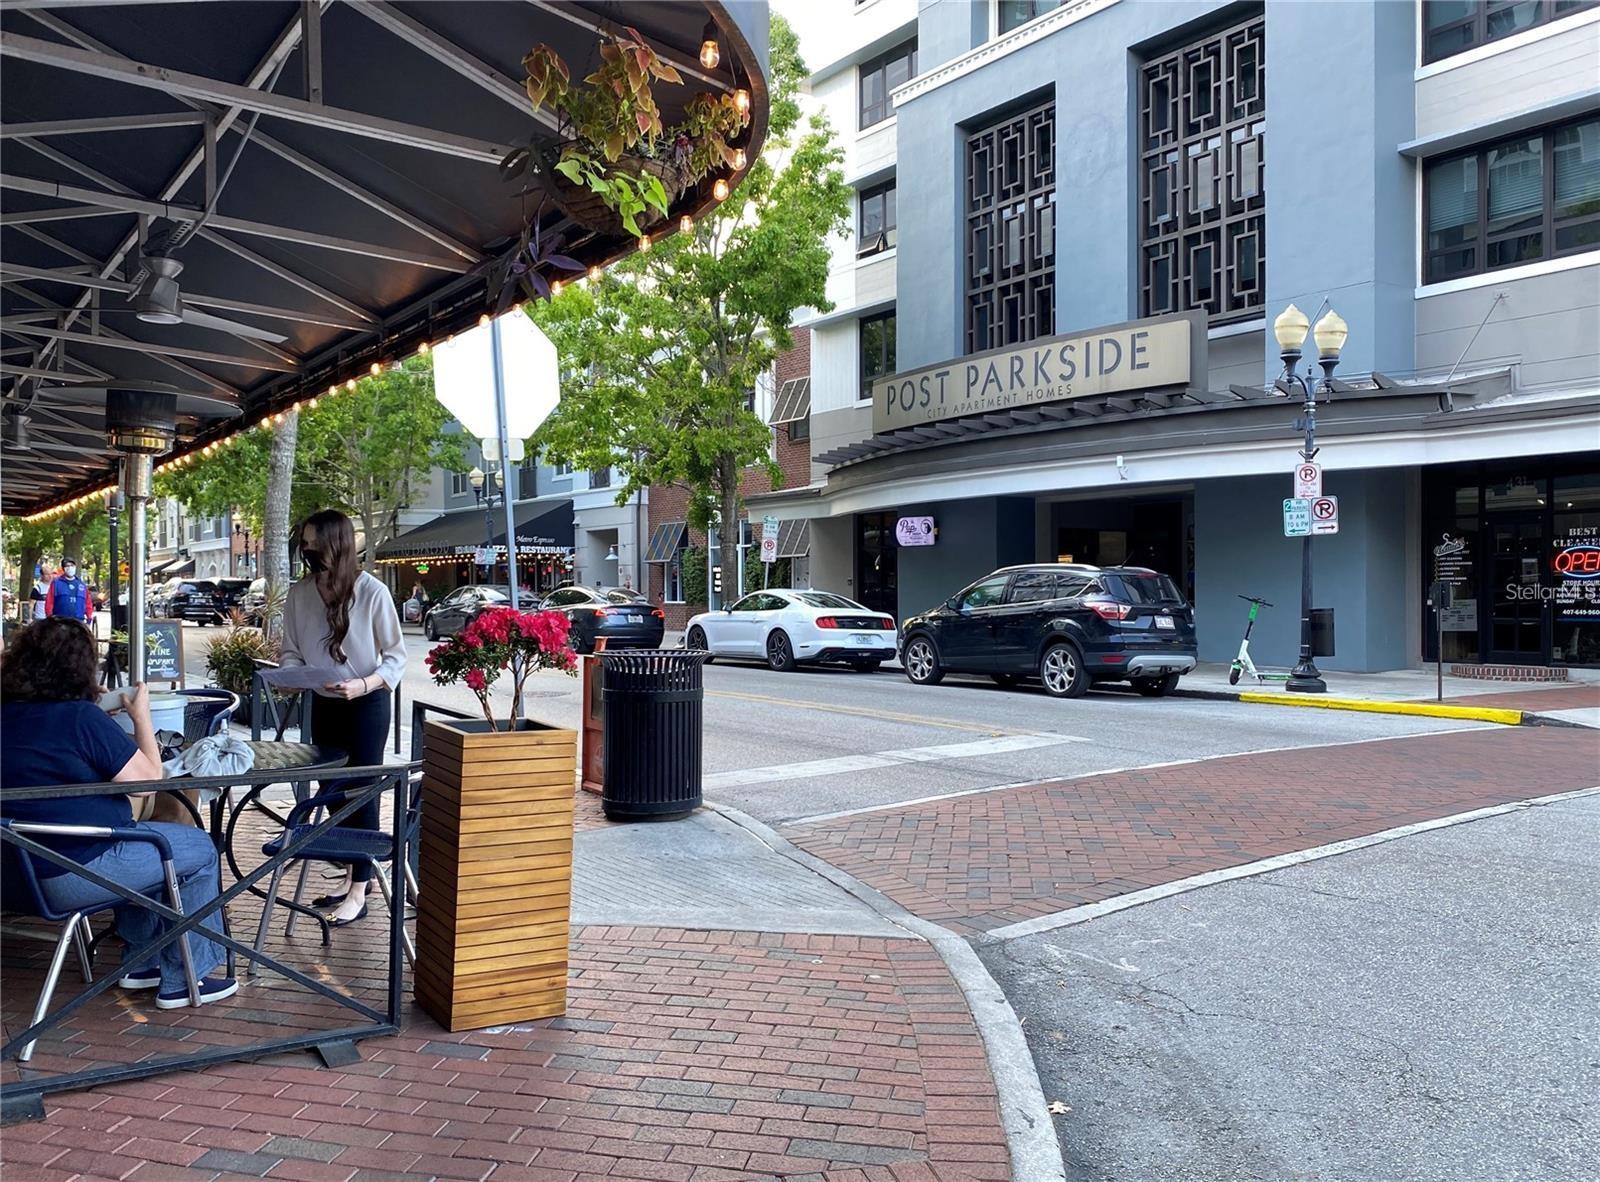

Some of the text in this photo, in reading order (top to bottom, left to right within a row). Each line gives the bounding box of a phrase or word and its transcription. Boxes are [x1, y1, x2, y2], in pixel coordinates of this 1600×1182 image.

[887, 331, 1150, 415] POST PARKSIDE
[927, 384, 1072, 419] CITY APARTMENT HOMES
[1569, 526, 1598, 536] BEST
[1552, 538, 1600, 547] CLEANE
[1555, 552, 1600, 573] OPE
